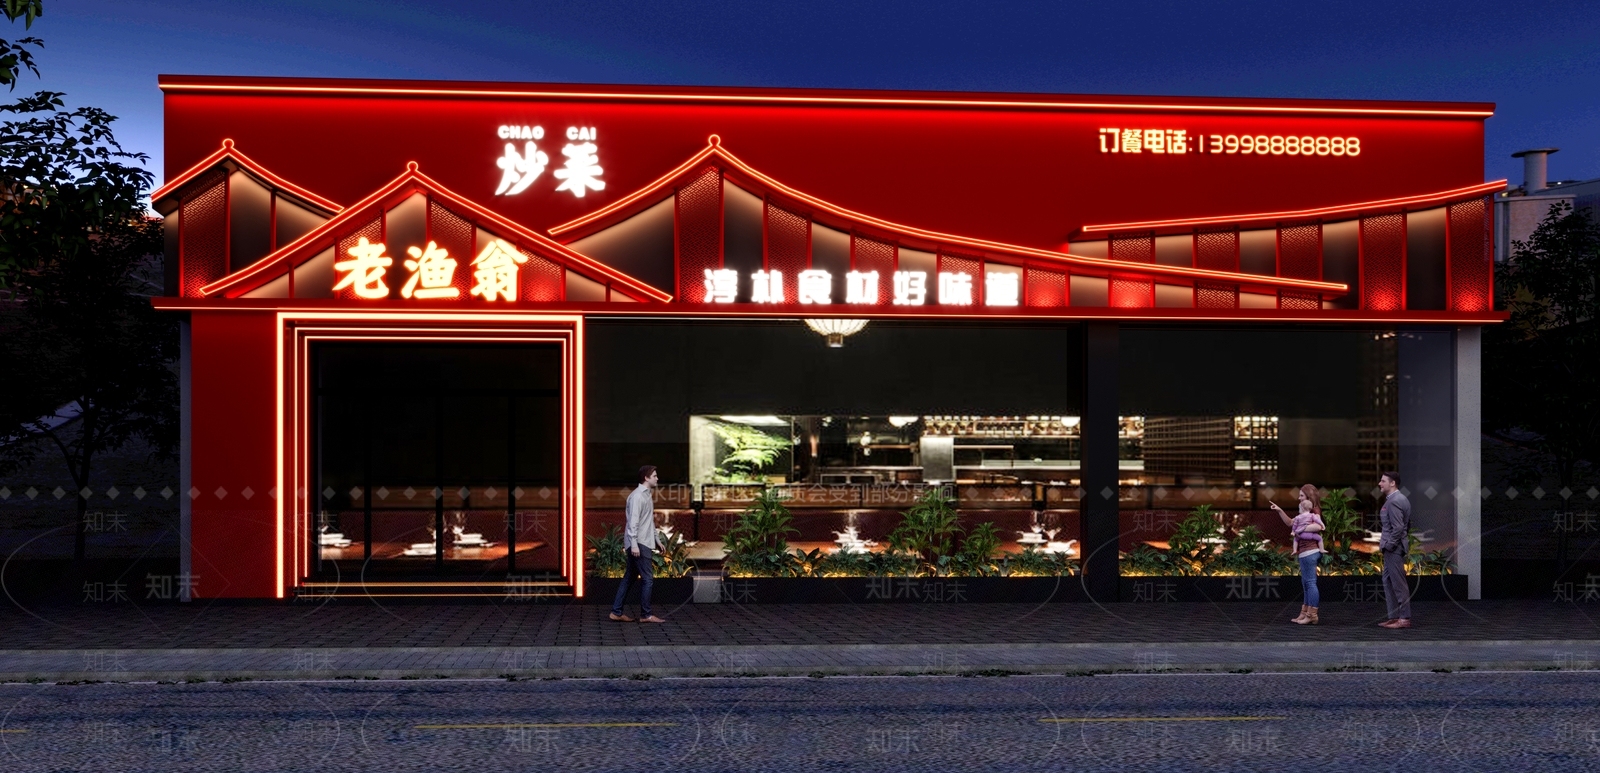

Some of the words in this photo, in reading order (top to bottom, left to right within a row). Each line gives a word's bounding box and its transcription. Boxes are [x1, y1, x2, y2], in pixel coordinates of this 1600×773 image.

[497, 124, 545, 140] CHAO
[566, 126, 597, 141] CAI
[494, 140, 606, 198] 炒菜
[332, 236, 529, 302] 老渔翁
[703, 268, 1019, 306] 淳朴食材好味道
